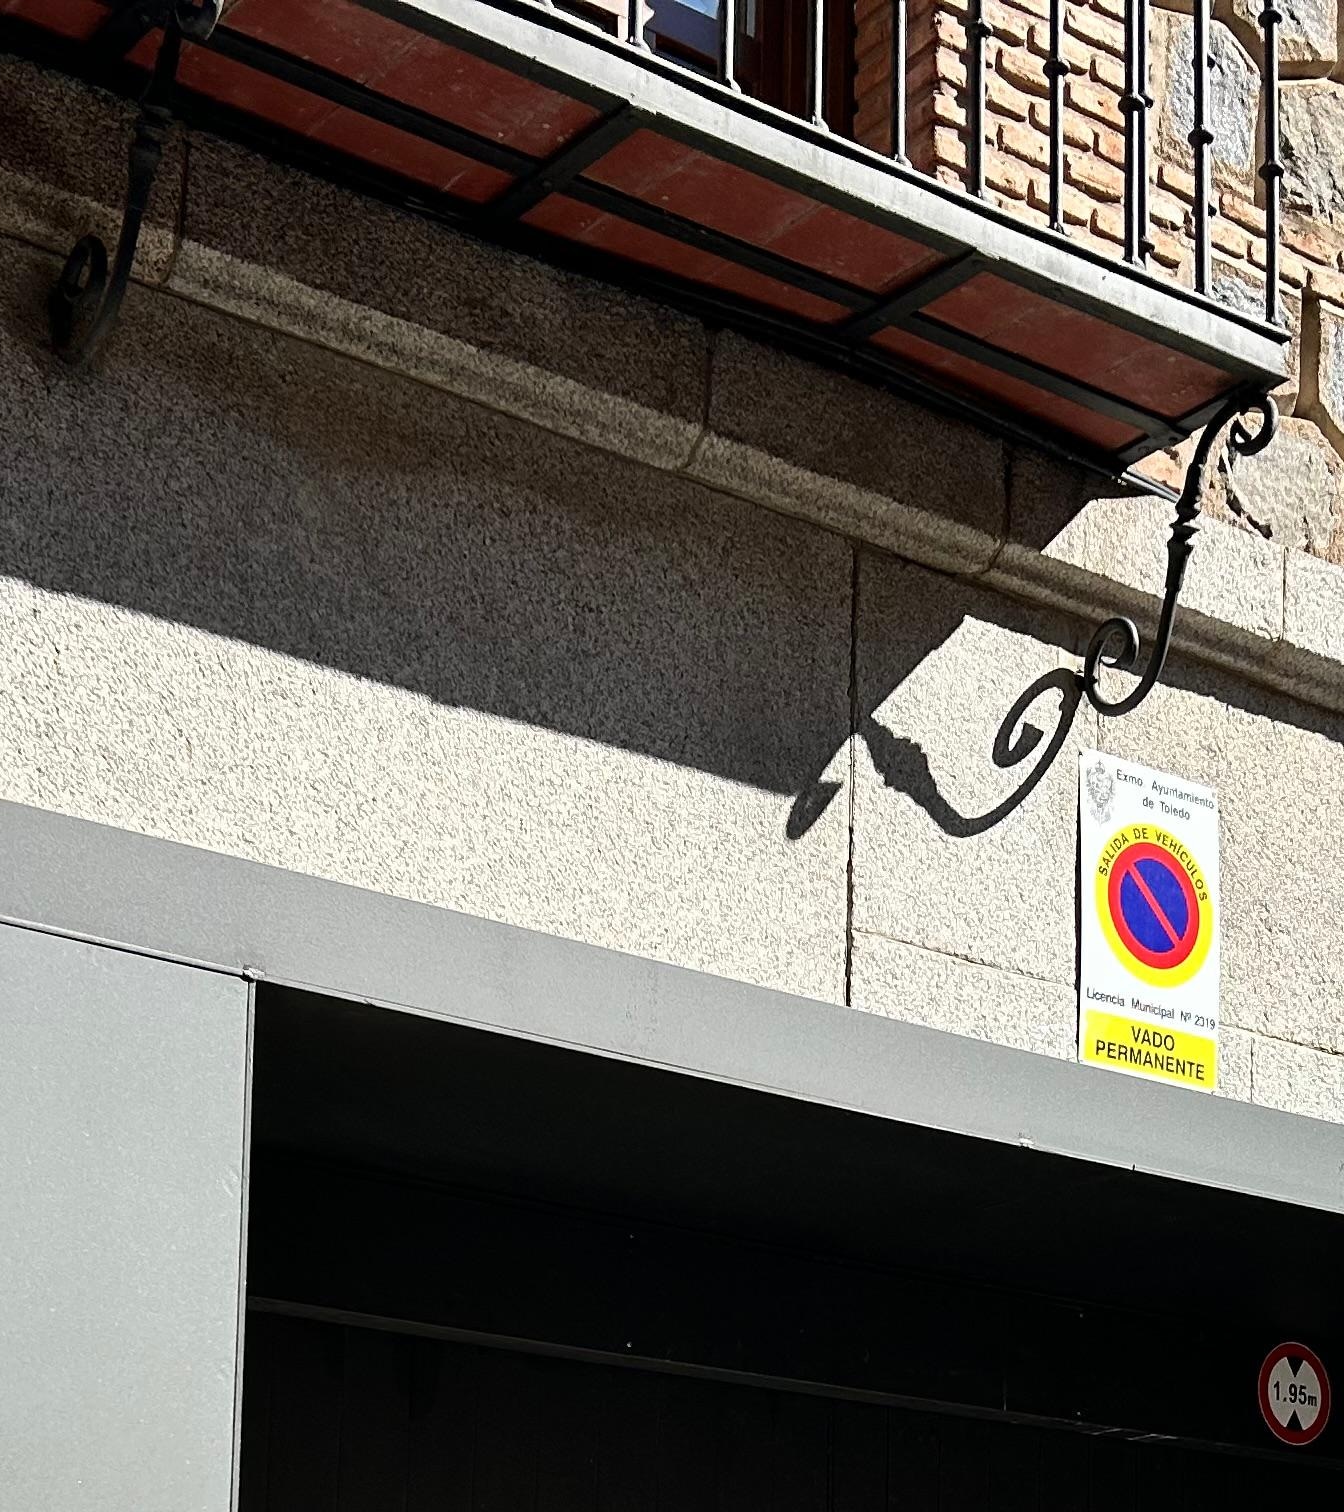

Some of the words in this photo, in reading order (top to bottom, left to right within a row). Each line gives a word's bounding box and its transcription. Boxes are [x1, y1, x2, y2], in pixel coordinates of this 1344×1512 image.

[1142, 796, 1154, 809] de
[1159, 801, 1190, 820] Toledo
[1151, 780, 1215, 810] Ayuntamiento
[1098, 833, 1130, 877] SALIDA
[1133, 827, 1149, 840] DE
[1086, 987, 1125, 1007] Licencia
[1131, 997, 1175, 1020] Municipal
[1194, 1014, 1216, 1031] 2319
[1130, 1025, 1175, 1051] VADO
[1096, 1039, 1205, 1081] PERMANENTE
